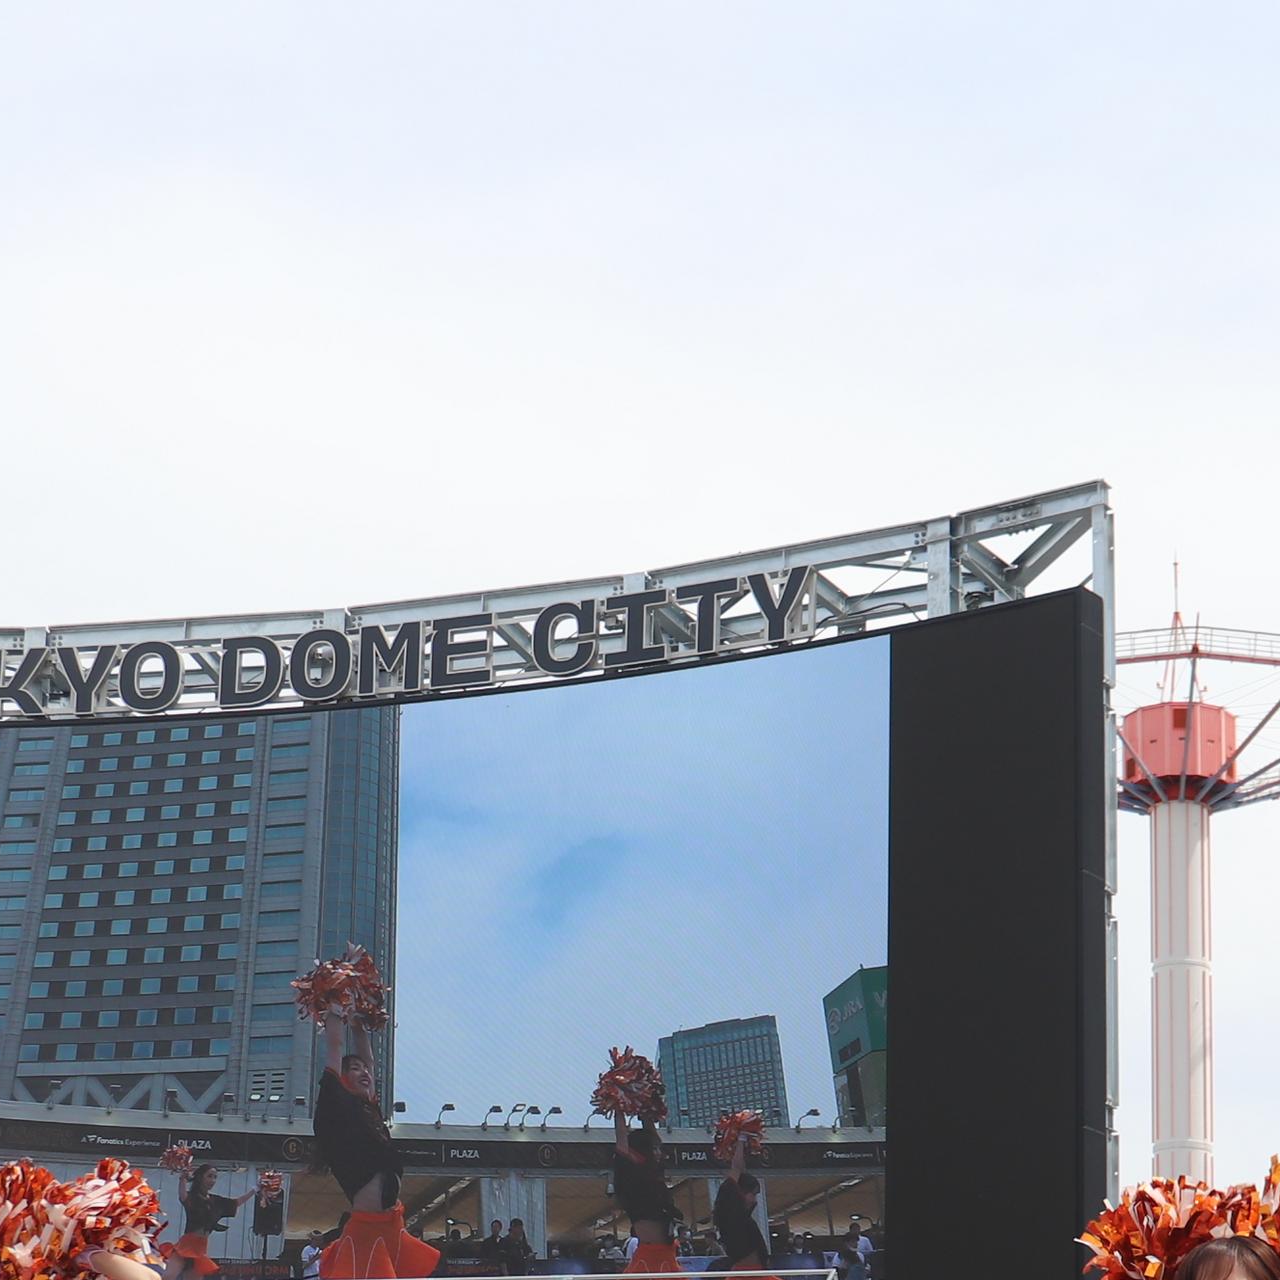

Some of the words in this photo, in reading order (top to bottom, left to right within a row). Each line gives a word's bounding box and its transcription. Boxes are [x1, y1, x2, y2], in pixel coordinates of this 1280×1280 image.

[219, 613, 496, 708] DOME
[532, 565, 814, 676] CITY
[96, 1136, 125, 1146] Fanatics
[450, 1149, 480, 1159] PLAZA
[681, 1151, 708, 1161] PLAZA
